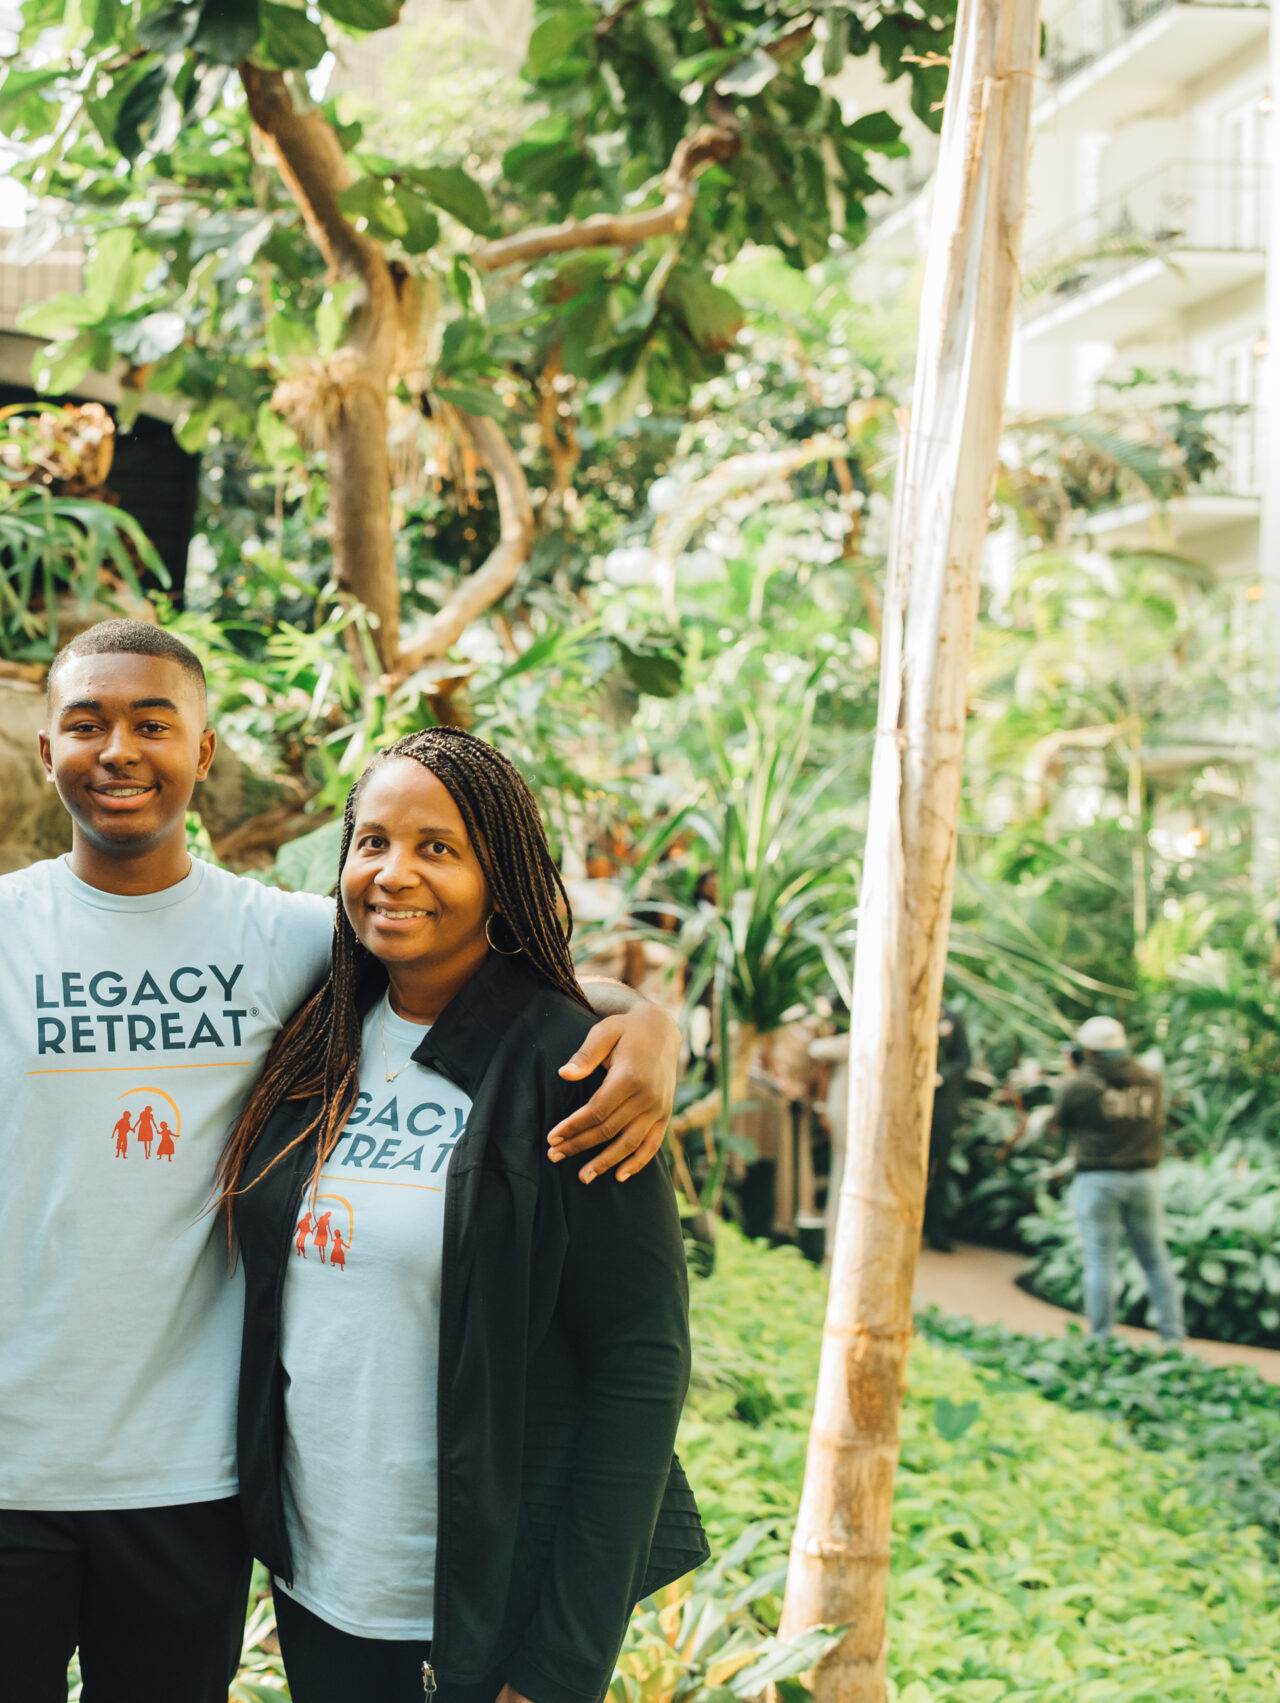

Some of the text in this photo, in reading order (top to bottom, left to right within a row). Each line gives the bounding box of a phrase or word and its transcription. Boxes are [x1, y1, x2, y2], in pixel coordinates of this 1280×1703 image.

[35, 964, 244, 1009] LEGACY
[346, 1091, 466, 1139] GACY
[325, 1131, 456, 1174] TREAT
